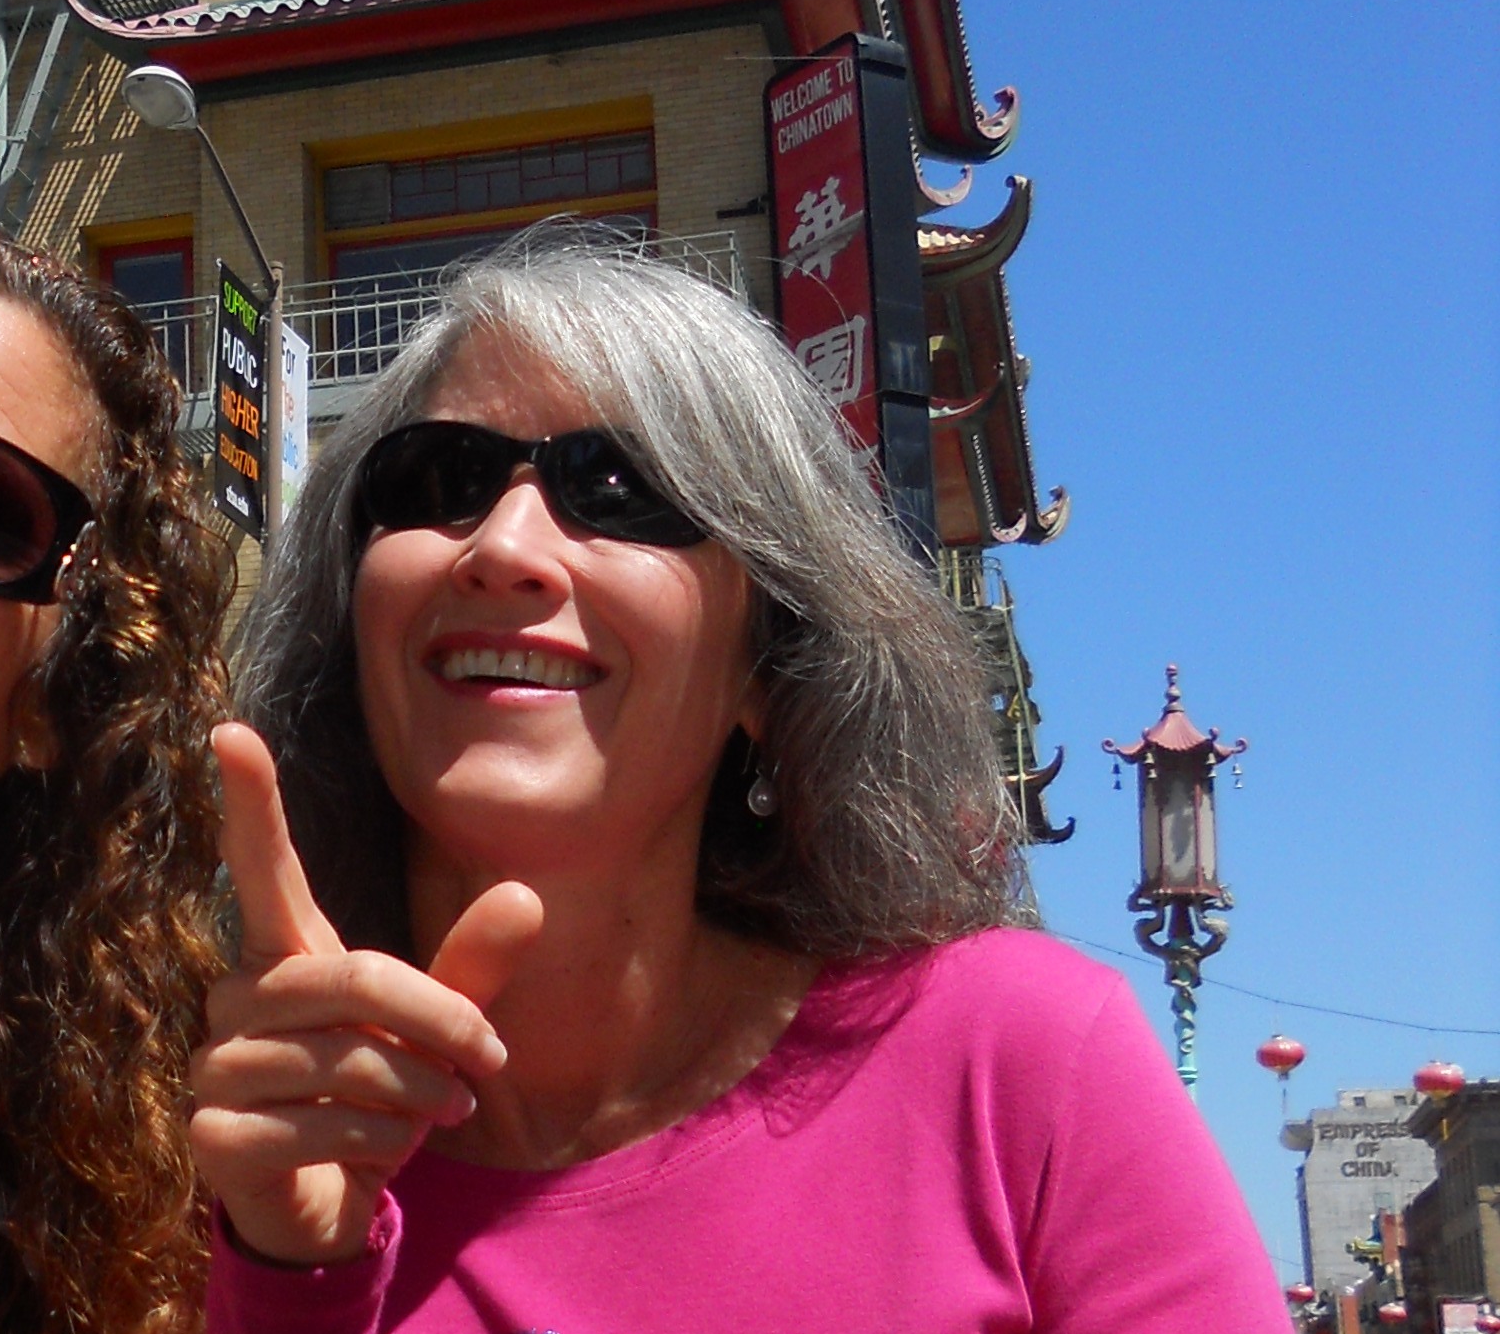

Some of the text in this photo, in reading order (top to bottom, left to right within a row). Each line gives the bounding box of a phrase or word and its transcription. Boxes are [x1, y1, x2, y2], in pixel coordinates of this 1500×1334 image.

[771, 57, 854, 123] WELCOME TO
[778, 91, 853, 154] CHINATOWN
[223, 280, 258, 336] SUPPORT
[221, 327, 258, 389] PUBLIC
[220, 380, 260, 440] HIGHER
[1356, 1142, 1380, 1158] OF
